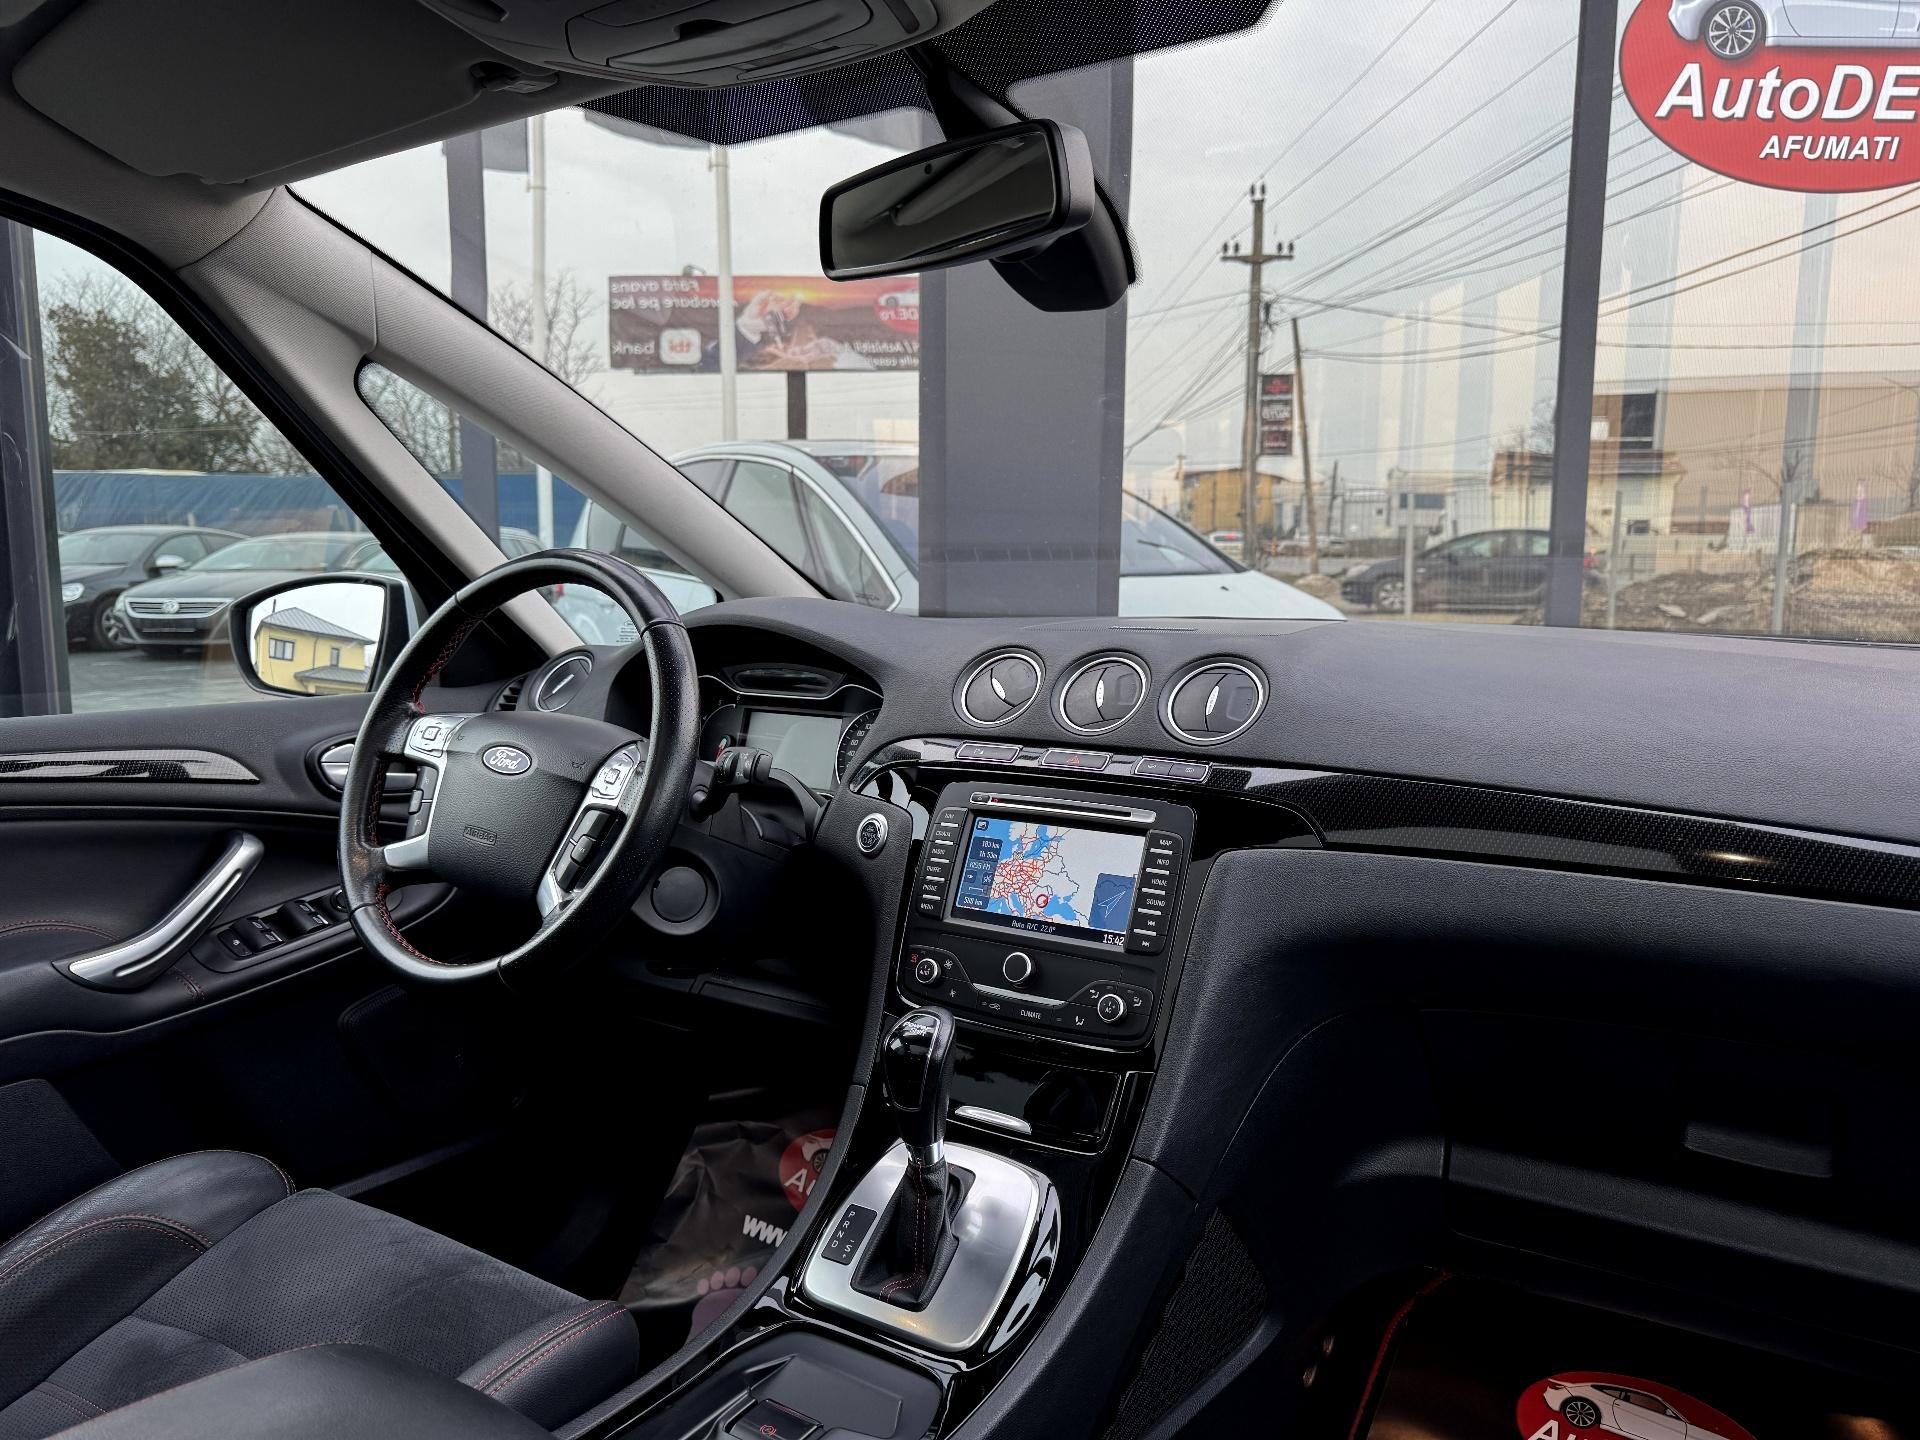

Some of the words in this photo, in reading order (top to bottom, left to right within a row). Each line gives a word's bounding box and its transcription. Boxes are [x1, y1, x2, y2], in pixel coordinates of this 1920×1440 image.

[1758, 134, 1900, 161] AFUMATI
[489, 748, 522, 770] Ford
[465, 826, 496, 843] AIRBAG
[1156, 858, 1170, 866] INFO
[1151, 878, 1168, 887] HOME
[1146, 898, 1166, 907] SOUND
[1011, 919, 1025, 929] Auto
[1102, 933, 1125, 946] 15:42
[1020, 1009, 1041, 1020] CLIMATE
[847, 1210, 856, 1218] P
[842, 1220, 850, 1229] R
[836, 1230, 845, 1238] N
[830, 1240, 839, 1248] D
[844, 1244, 853, 1253] S
